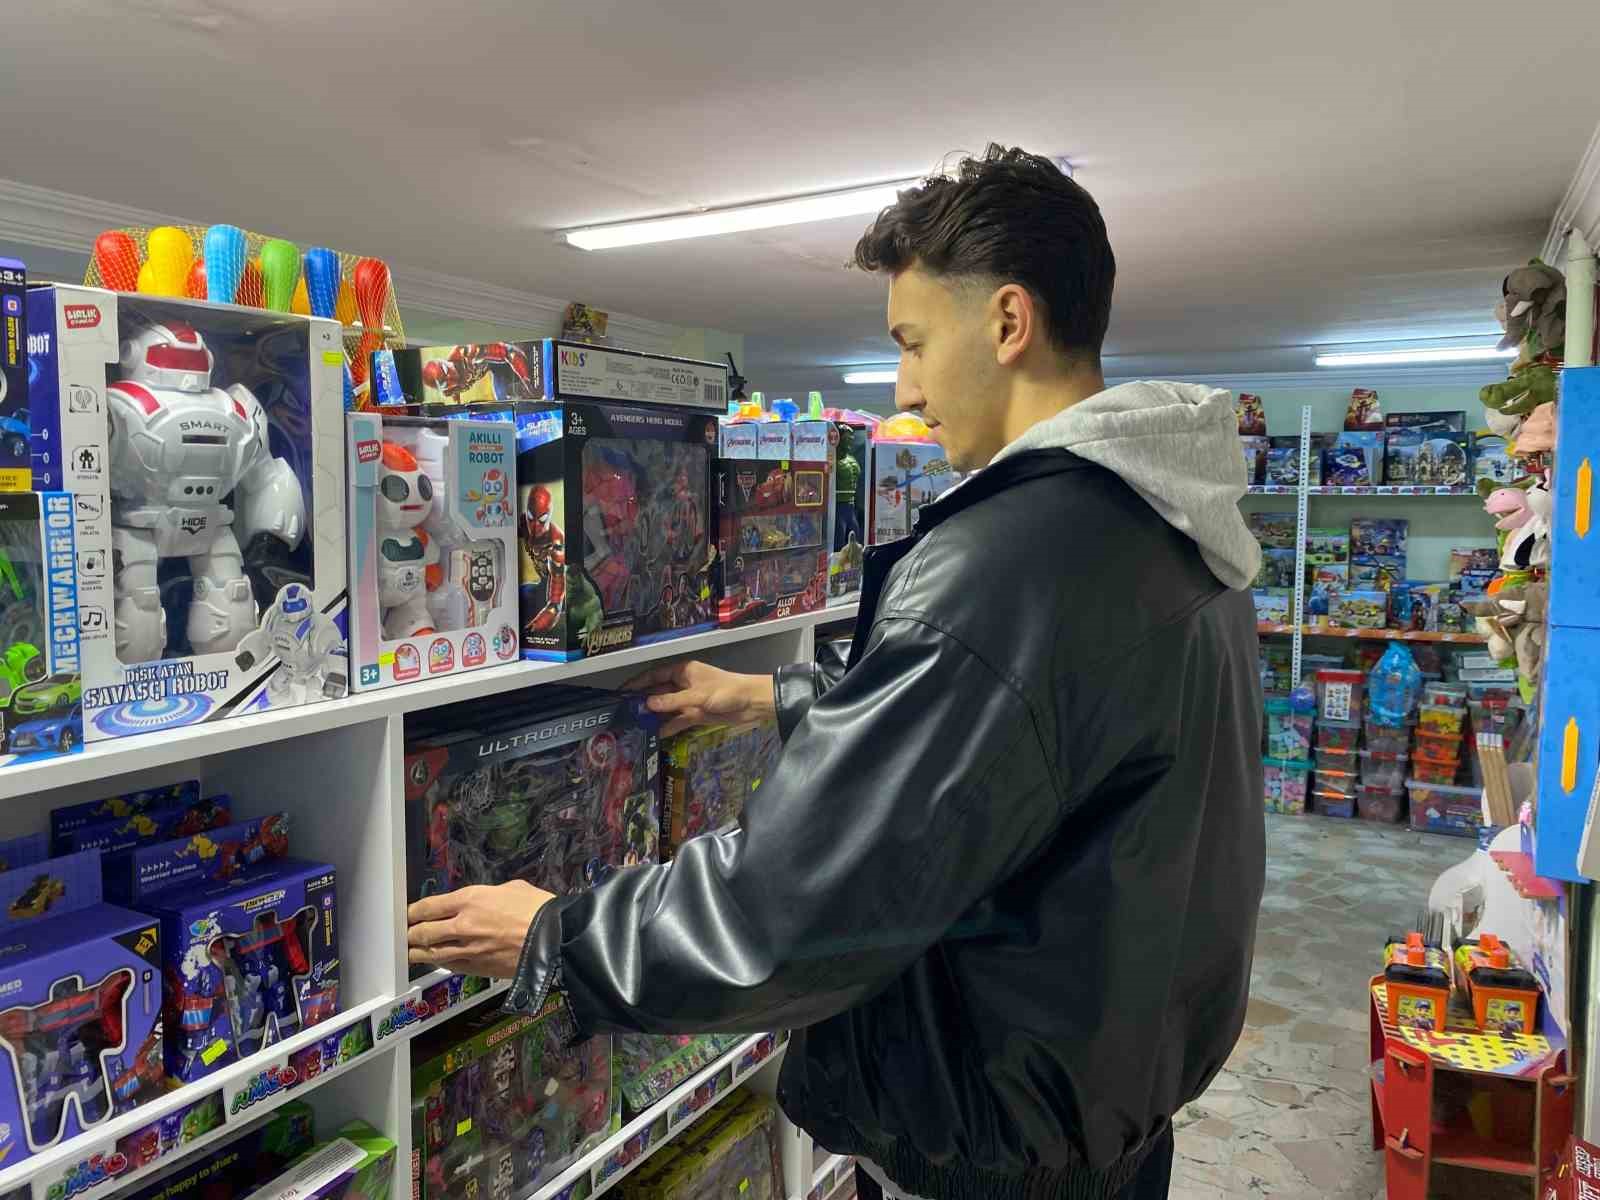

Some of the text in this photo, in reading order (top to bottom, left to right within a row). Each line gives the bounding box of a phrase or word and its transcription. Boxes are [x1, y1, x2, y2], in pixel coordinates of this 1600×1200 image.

[561, 351, 585, 368] KIDS
[179, 419, 230, 433] SMART
[571, 412, 583, 426] 3+
[568, 426, 586, 436] AGES
[469, 432, 501, 445] AKILLI
[469, 452, 505, 464] ROBOT
[182, 516, 207, 526] HIDE
[47, 496, 81, 675] MECHWARRIOR
[777, 596, 797, 609] ALLOY
[777, 606, 791, 617] CAR
[362, 668, 378, 682] 3+
[172, 670, 228, 696] ROBOT
[479, 712, 612, 757] ULTRON AGE
[166, 1152, 239, 1198] happy to share
